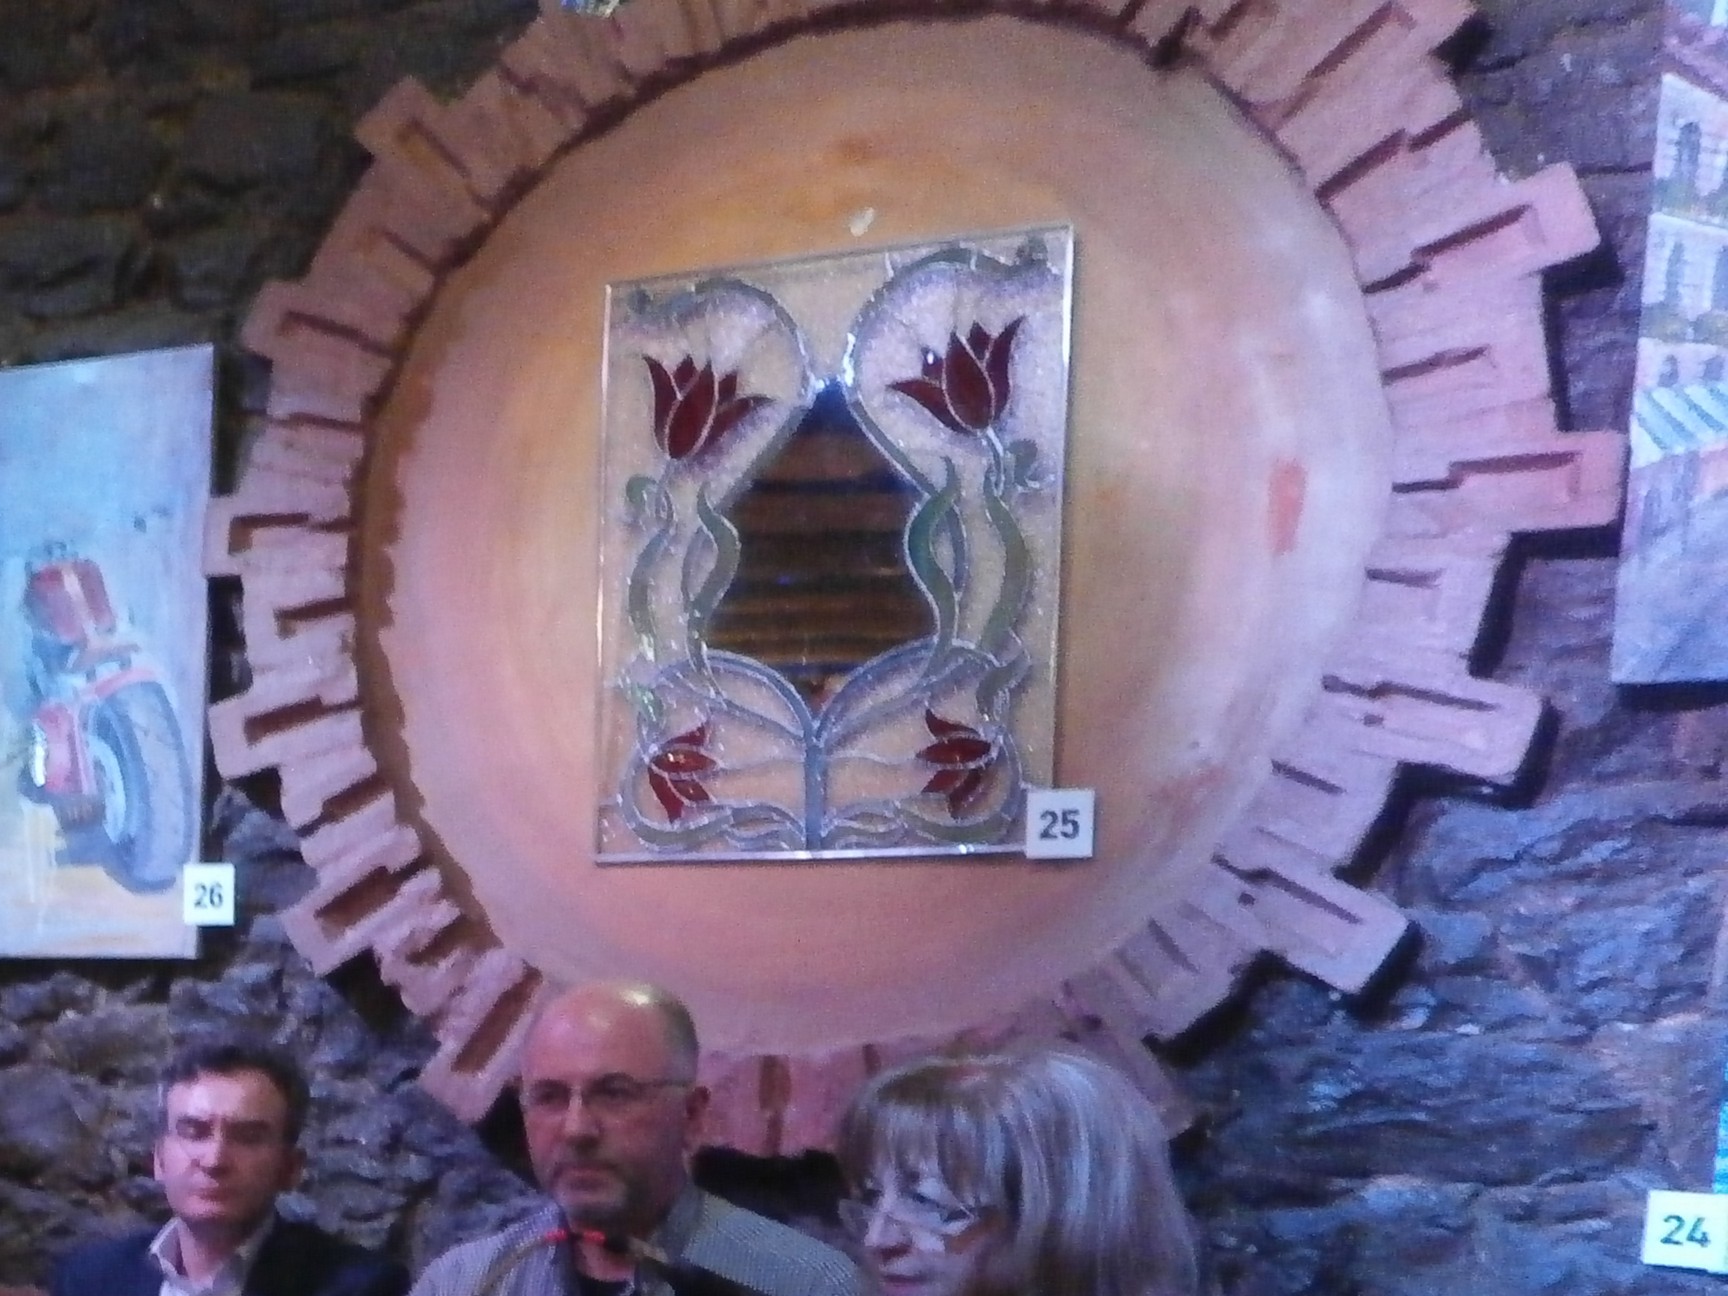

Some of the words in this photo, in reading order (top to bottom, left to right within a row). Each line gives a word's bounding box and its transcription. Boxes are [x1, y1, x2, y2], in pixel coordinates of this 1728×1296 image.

[1040, 810, 1080, 839] 25
[194, 882, 223, 908] 26
[1660, 1215, 1710, 1248] 24
